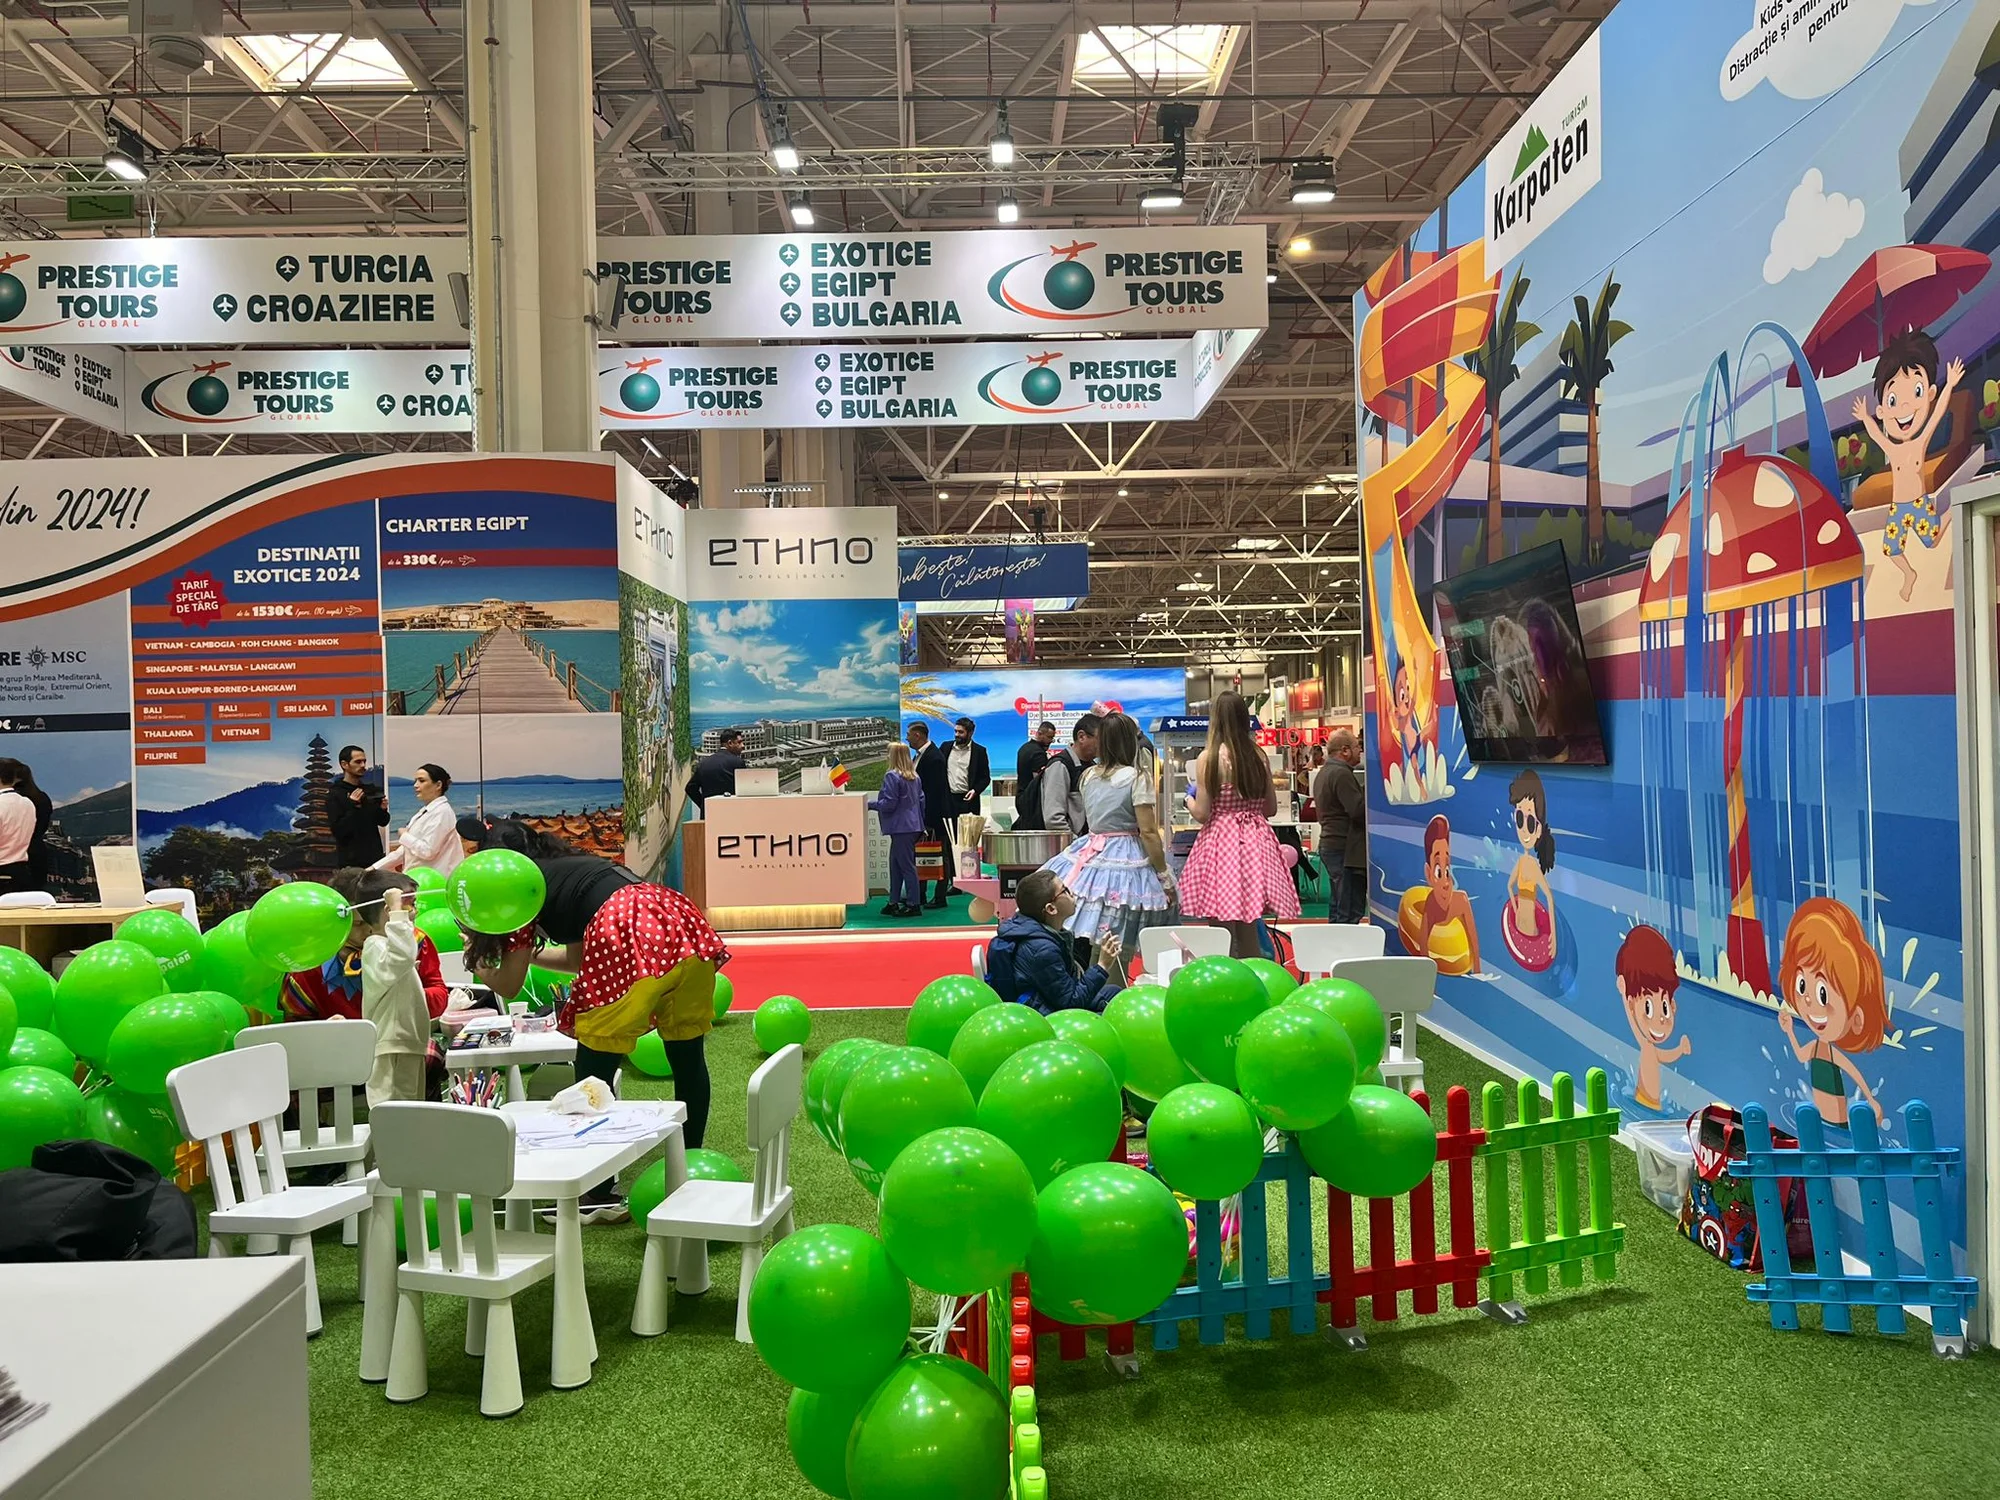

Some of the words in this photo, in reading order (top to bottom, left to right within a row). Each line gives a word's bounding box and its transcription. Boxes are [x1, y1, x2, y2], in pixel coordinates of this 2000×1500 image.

[1759, 0, 1784, 29] Kids
[1561, 95, 1588, 131] TURISM
[1493, 116, 1588, 241] Karpaten
[811, 241, 931, 267] EXOTICE
[1105, 250, 1242, 276] PRESTIGE
[38, 264, 178, 289] PRESTIGE
[308, 254, 434, 283] TURCIA
[597, 261, 731, 285] PRESTIGE
[812, 271, 896, 297] EGIPT
[1124, 281, 1224, 306] TOURS
[58, 294, 158, 318] TOURS
[246, 294, 435, 322] CROAZIERE
[813, 299, 961, 328] BULGARIA
[1146, 306, 1206, 314] GLOBAL
[78, 319, 139, 328] GLOBAL
[33, 357, 61, 378] TOURS
[82, 357, 112, 379] EXOTICE
[839, 352, 935, 372] EXOTICE
[1069, 359, 1177, 380] PRESTIGE
[82, 371, 103, 389] EGIPT
[237, 371, 349, 390] PRESTIGE
[669, 366, 777, 386] PRESTIGE
[840, 375, 906, 396] EGIPT
[82, 384, 119, 409] BULGARIA
[684, 389, 763, 410] TOURS
[1084, 382, 1162, 403] TOURS
[253, 395, 334, 414] TOURS
[841, 396, 958, 420] BULGARIA
[47, 487, 150, 531] 2024!
[386, 518, 472, 533] CHARTER
[476, 516, 529, 531] EGIPT
[258, 547, 360, 564] DESTINAȚII
[403, 554, 437, 565] 330€
[234, 568, 312, 584] EXOTICE
[316, 567, 360, 582] 2024
[181, 580, 209, 591] TARIF
[176, 591, 217, 602] SPECIAL
[176, 604, 190, 614] DE
[191, 601, 219, 613] TÂRG
[252, 605, 293, 617] 1530€
[145, 641, 183, 650] VIETNAM
[190, 639, 236, 648] CAMBOGIA
[241, 638, 260, 648] KOH
[262, 638, 292, 647] CHANG
[297, 637, 339, 646] BANGKOK
[51, 651, 87, 664] MSC
[145, 664, 193, 673] SINGAPORE
[200, 663, 243, 672] MALAYSIA
[250, 662, 296, 671] LANGKAWI
[6, 676, 23, 684] grup
[33, 673, 56, 682] Marea
[51, 682, 84, 691] Extremul
[8, 692, 26, 700] Nord
[146, 686, 175, 695] KUALA
[143, 707, 162, 715] BALI
[218, 705, 238, 713] BALI
[284, 705, 297, 713] SRI
[298, 704, 328, 712] LANKA
[350, 702, 374, 711] INDIA
[143, 730, 194, 738] THAILANDA
[221, 728, 260, 737] VIETNAM
[144, 752, 178, 760] FILIPINE
